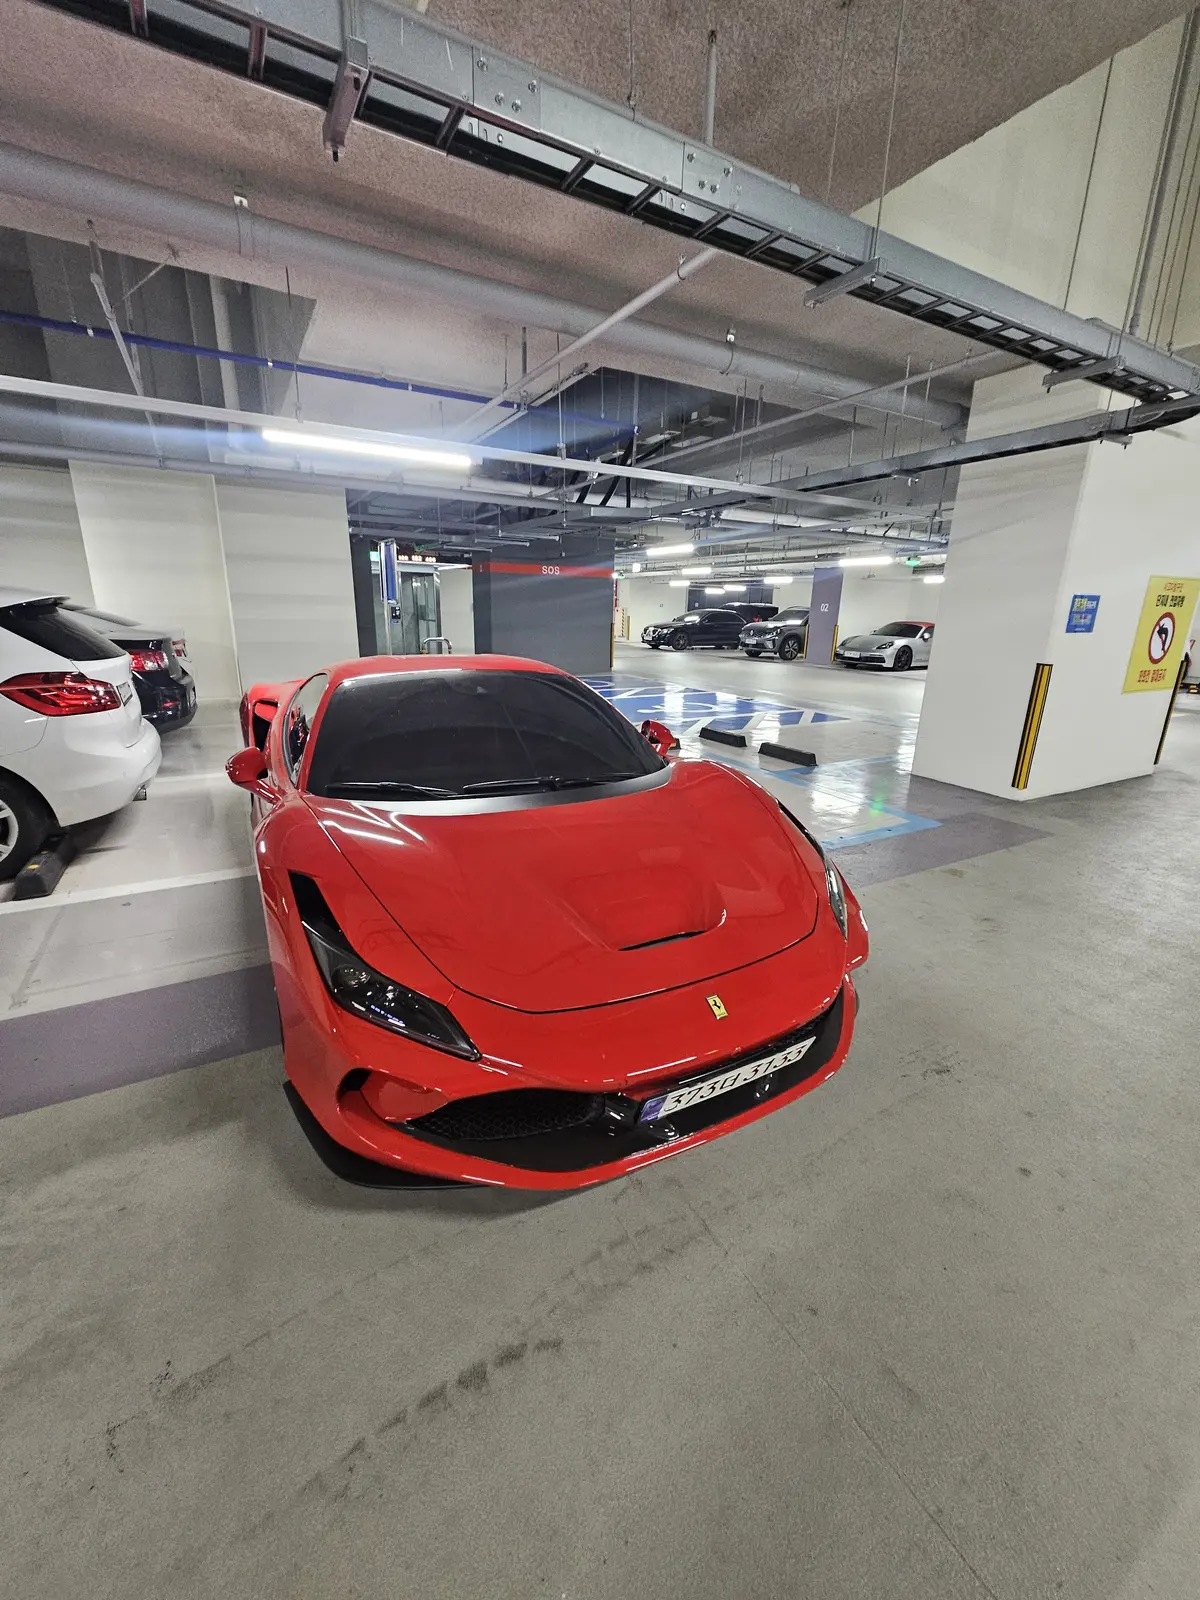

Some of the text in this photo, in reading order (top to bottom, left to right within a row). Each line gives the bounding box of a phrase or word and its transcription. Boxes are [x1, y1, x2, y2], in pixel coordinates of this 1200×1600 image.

[541, 565, 560, 576] SOS
[820, 603, 829, 612] 02
[743, 1046, 808, 1082] 3133
